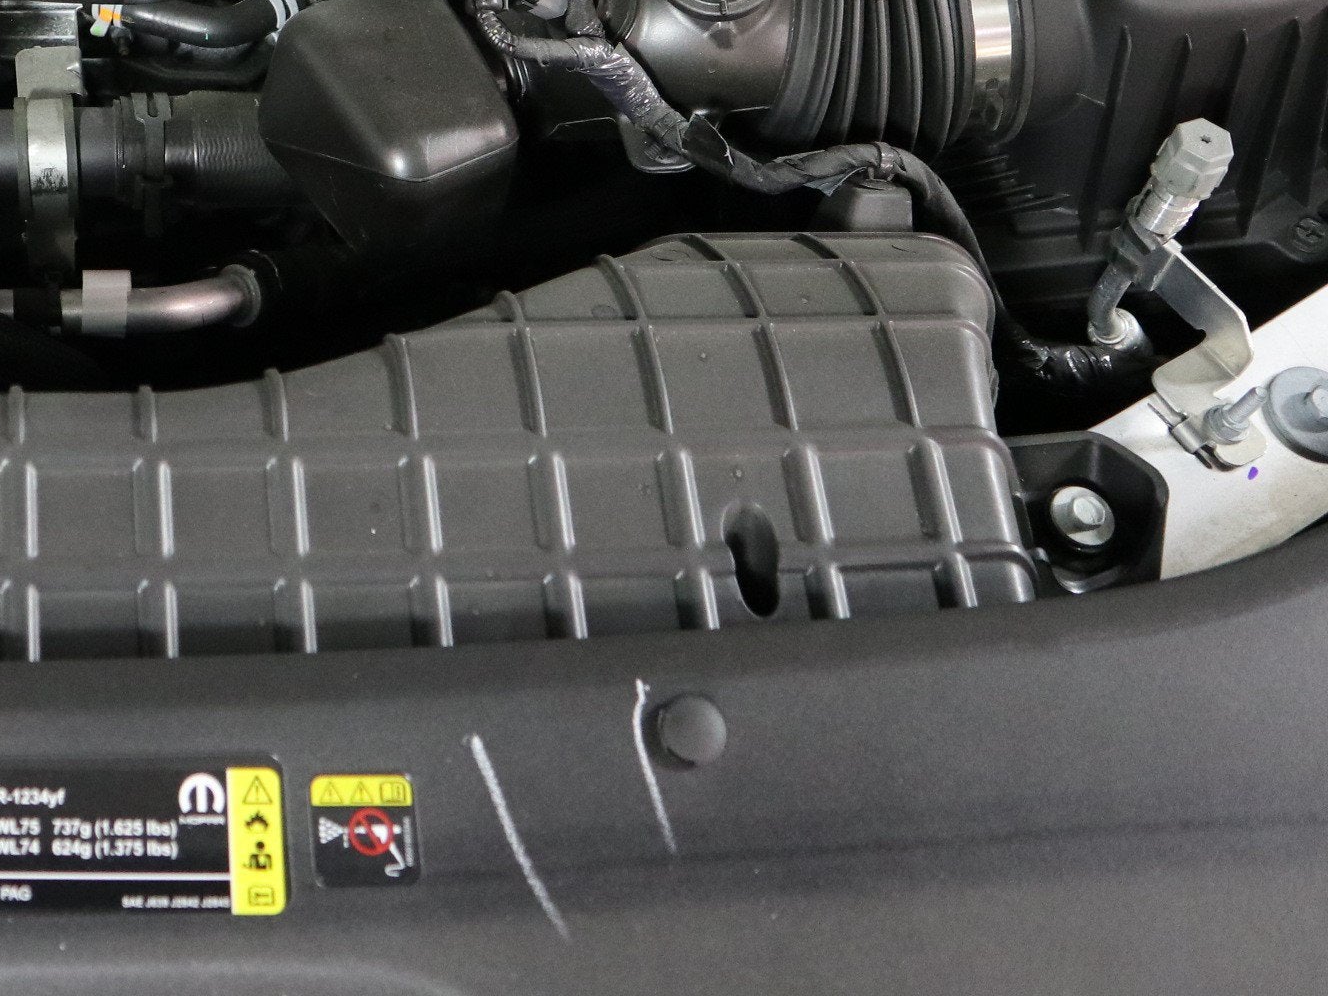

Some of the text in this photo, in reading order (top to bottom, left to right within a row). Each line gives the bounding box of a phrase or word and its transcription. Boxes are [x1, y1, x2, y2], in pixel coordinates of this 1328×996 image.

[52, 817, 92, 840] 737g
[52, 838, 92, 861] 624g
[94, 838, 145, 861] (1.375
